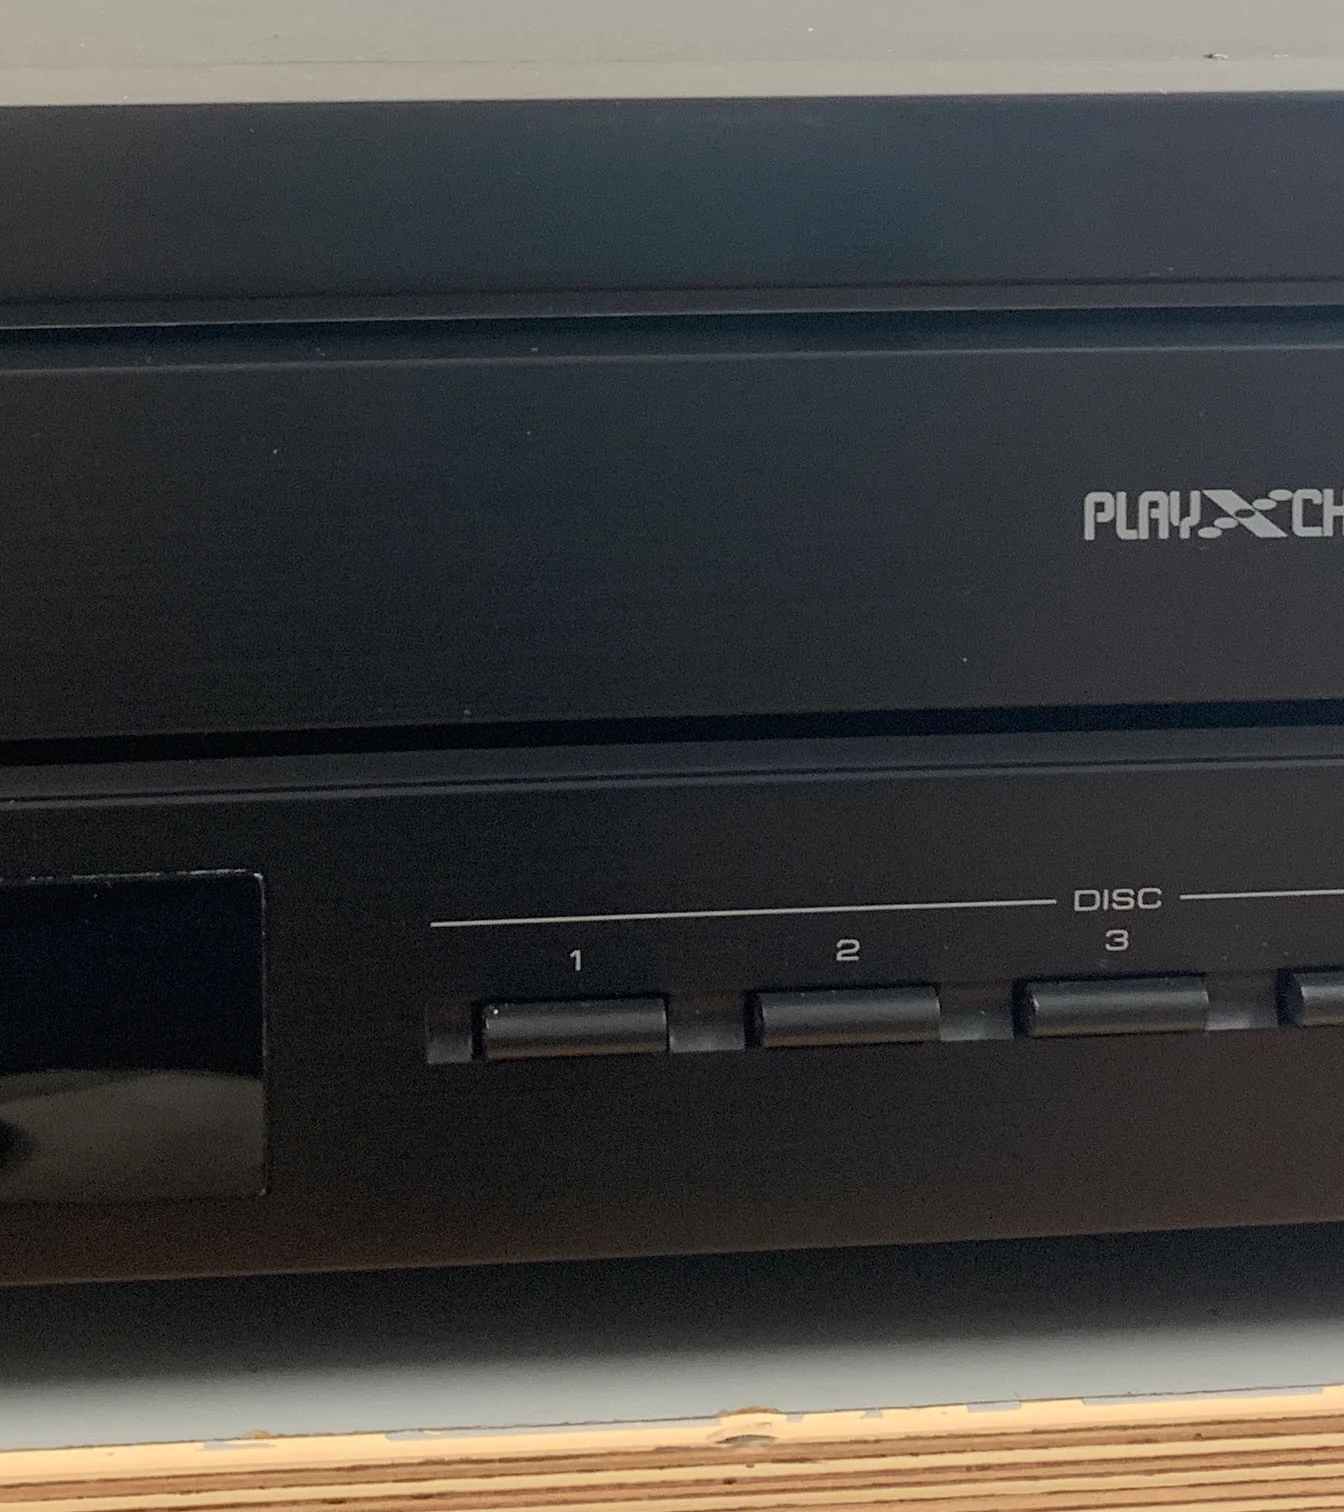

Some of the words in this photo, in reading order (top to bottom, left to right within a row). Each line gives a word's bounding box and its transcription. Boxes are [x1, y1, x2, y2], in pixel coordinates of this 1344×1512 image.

[1073, 888, 1163, 912] DISC
[568, 949, 583, 972] 1
[835, 939, 861, 962] 2
[1105, 929, 1130, 952] 3
